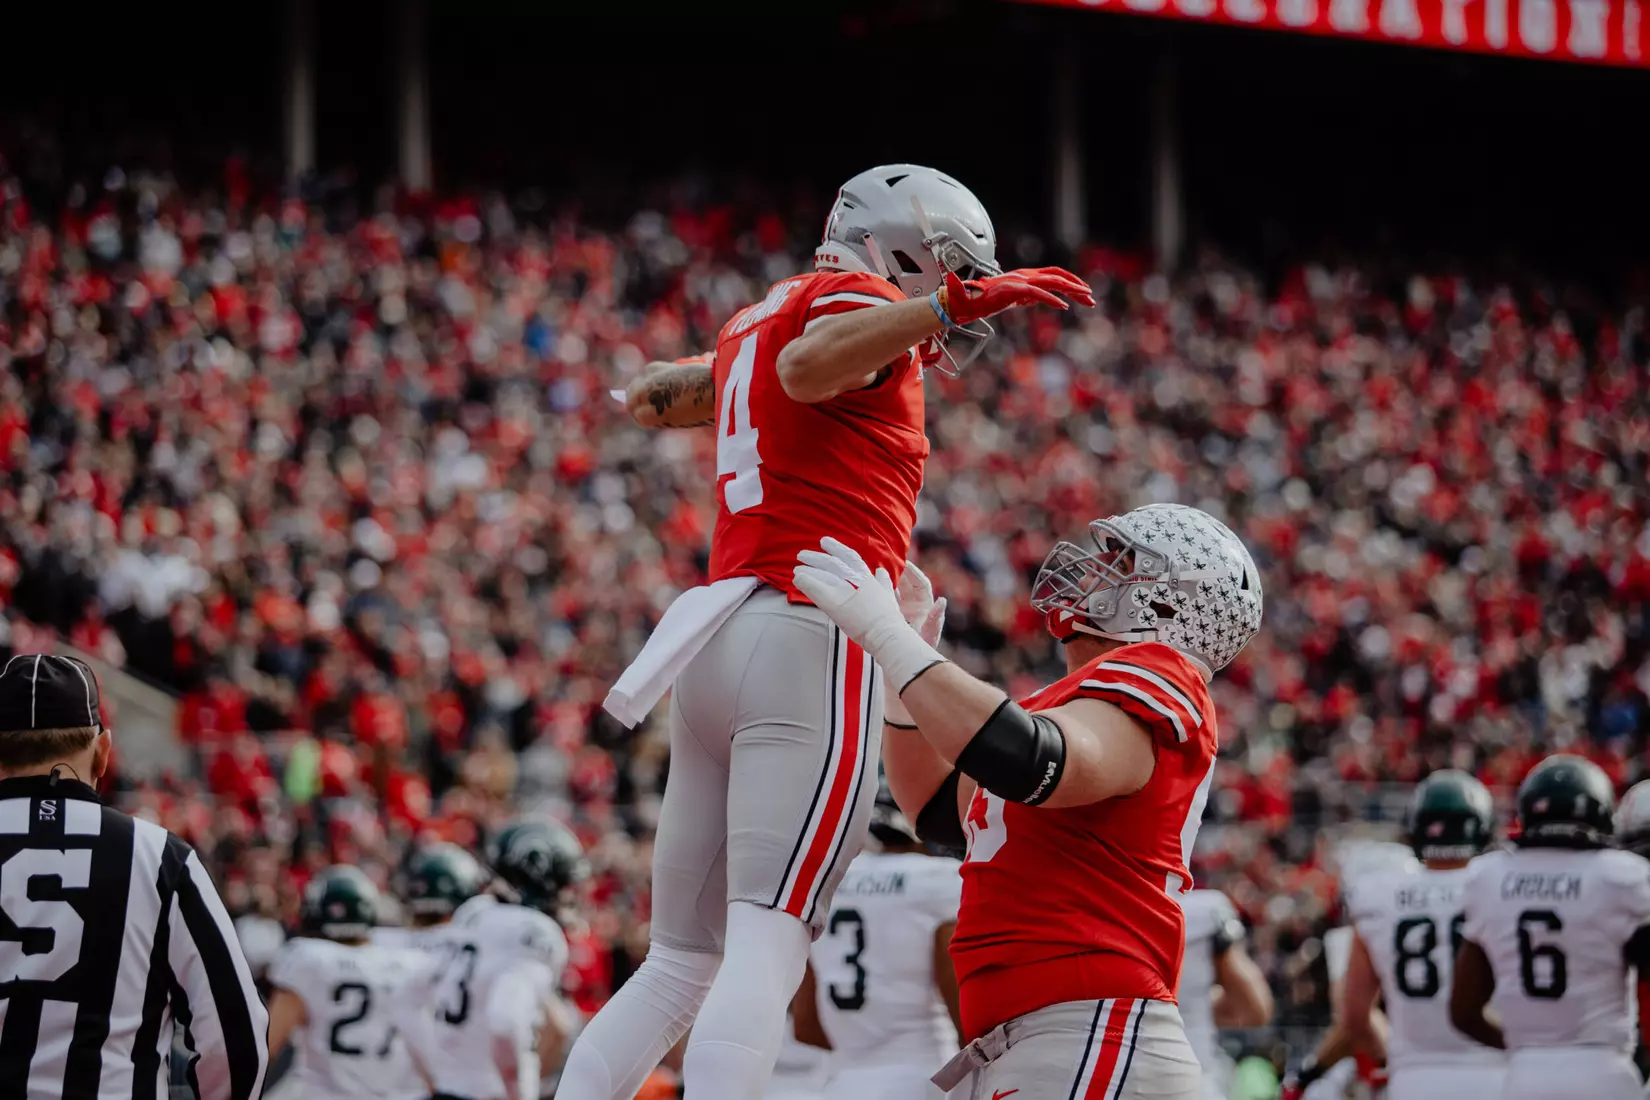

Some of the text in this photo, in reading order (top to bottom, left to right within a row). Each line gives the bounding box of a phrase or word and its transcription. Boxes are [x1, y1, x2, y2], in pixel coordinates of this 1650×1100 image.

[717, 331, 763, 514] 4
[0, 848, 93, 983] S
[1501, 872, 1582, 900] CROUCH
[828, 907, 866, 1011] 3
[1395, 912, 1466, 998] 8
[1518, 910, 1567, 998] 6
